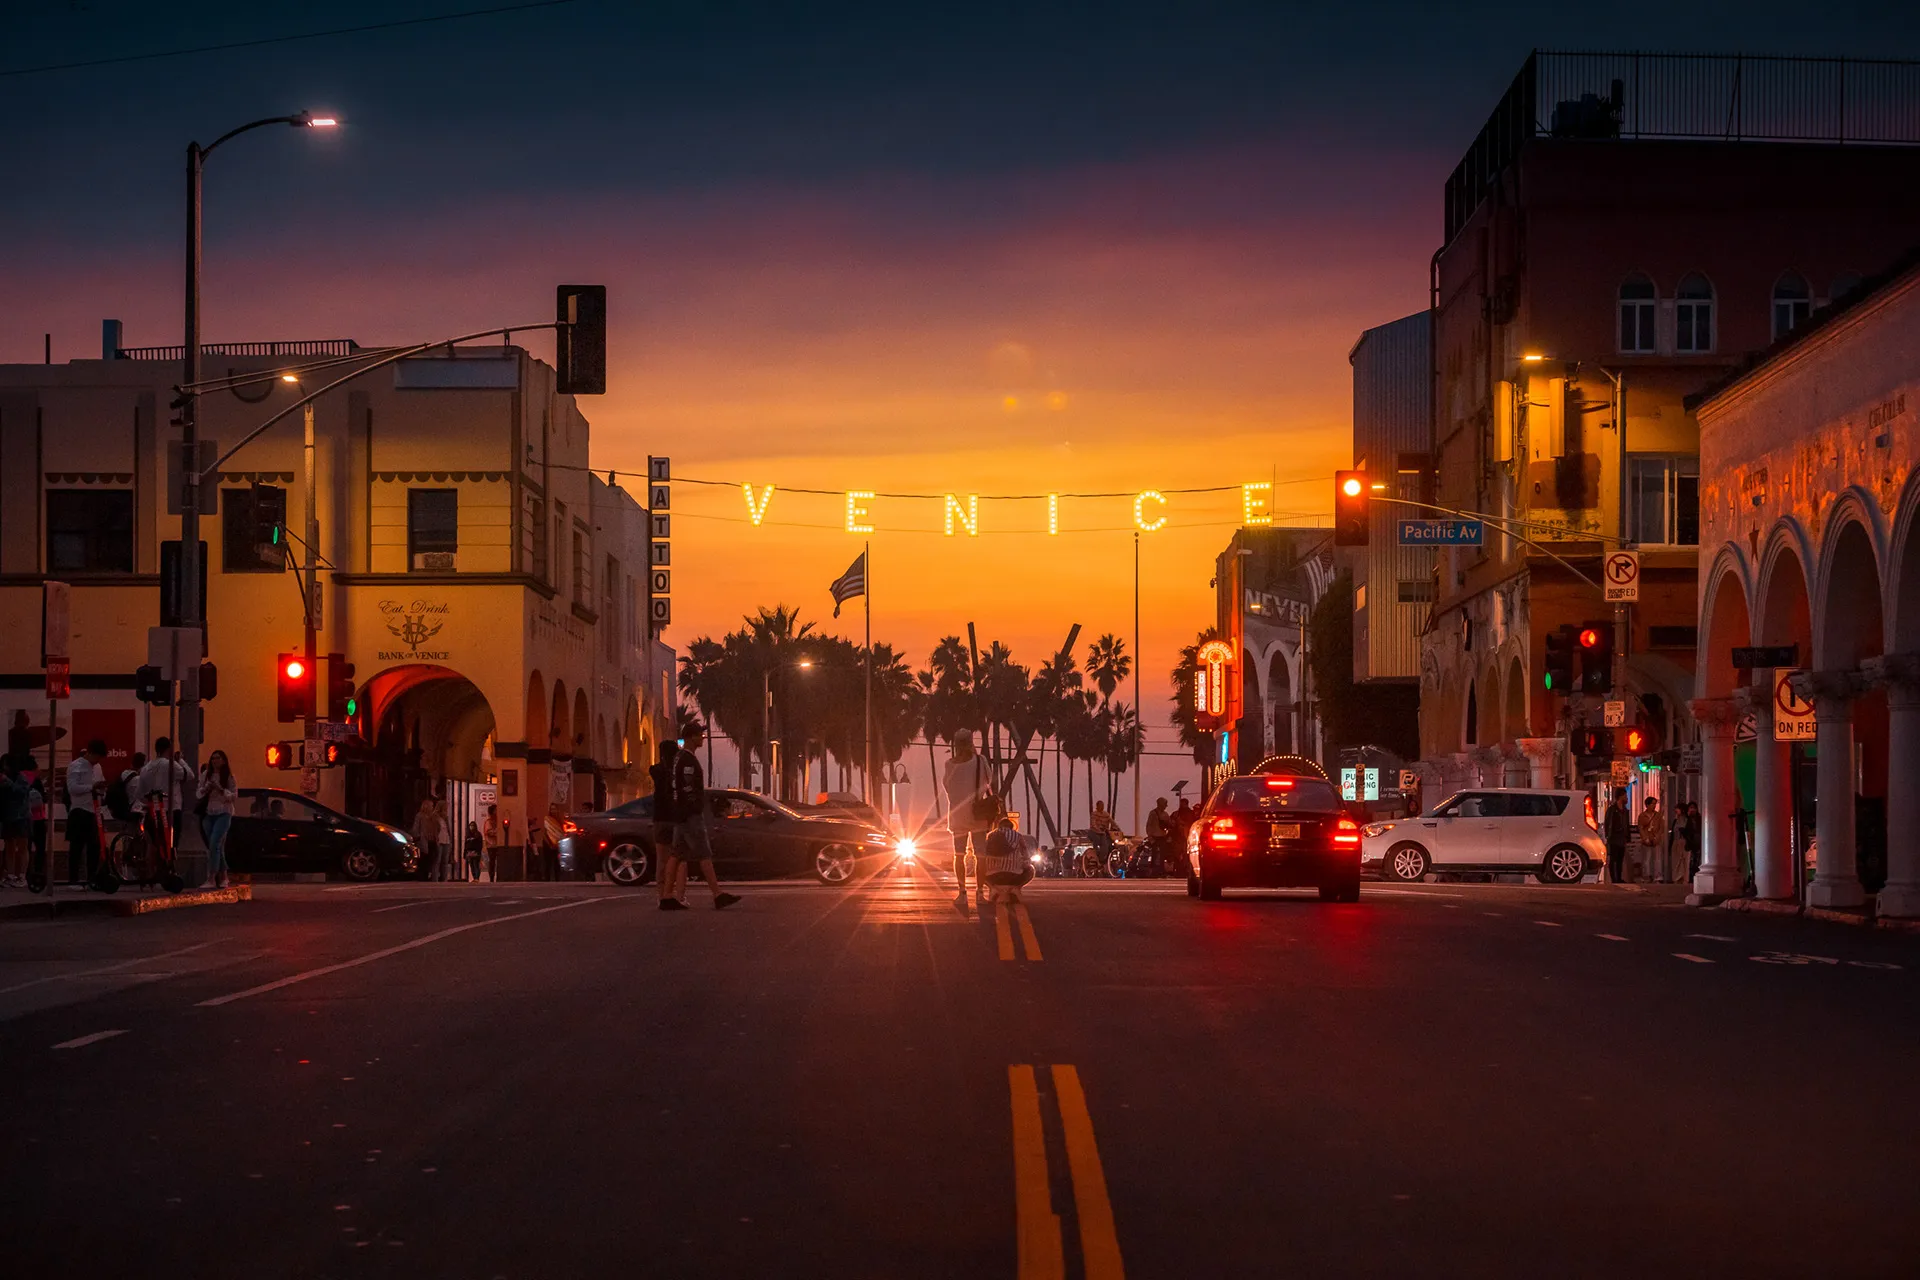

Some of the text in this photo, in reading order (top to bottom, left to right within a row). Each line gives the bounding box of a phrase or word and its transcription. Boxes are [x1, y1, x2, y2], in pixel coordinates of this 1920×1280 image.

[741, 482, 1273, 537] VENICE
[653, 459, 667, 619] TATTOO
[1404, 525, 1477, 539] Pacific Av
[378, 599, 450, 613] Eat. Drink.
[378, 651, 404, 660] BANK
[415, 651, 449, 660] VENICE
[1778, 722, 1818, 733] ON RED
